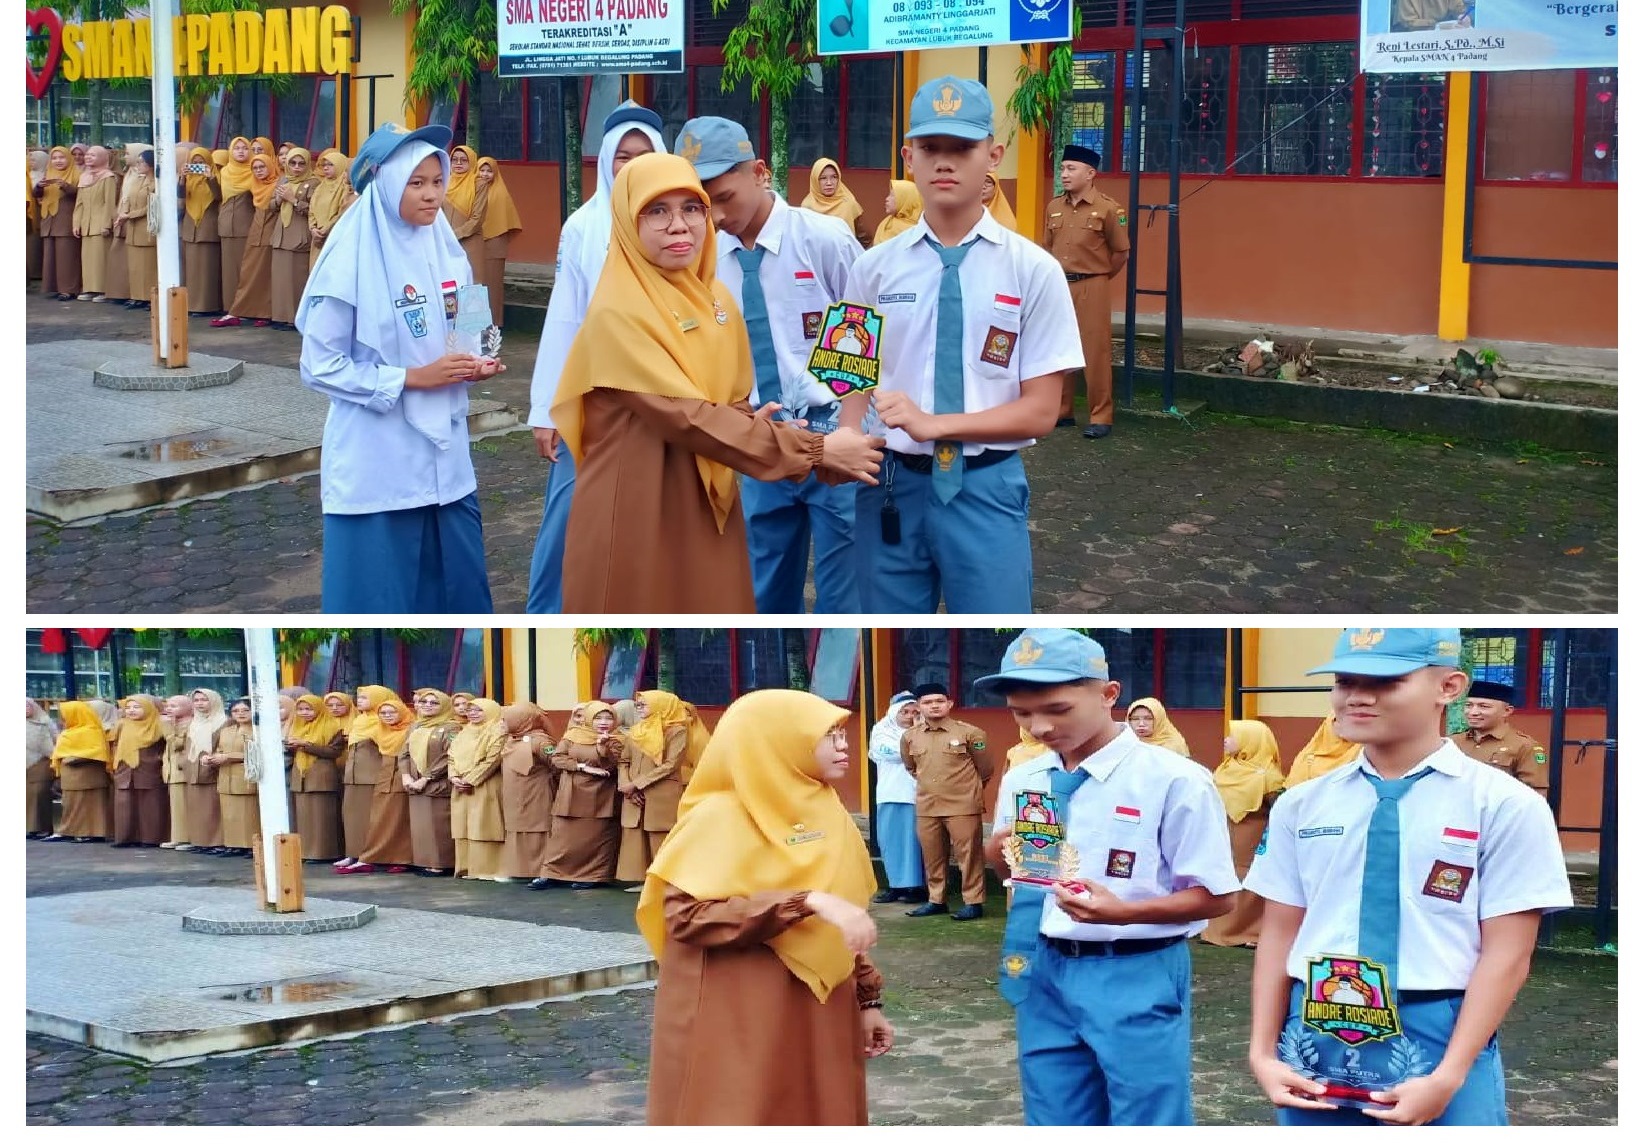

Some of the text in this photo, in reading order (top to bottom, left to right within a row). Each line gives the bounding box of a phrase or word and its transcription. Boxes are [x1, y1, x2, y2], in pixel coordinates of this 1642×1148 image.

[506, 0, 668, 25] SMA NEGERI 4 PADANG
[893, 2, 905, 13] 08
[884, 8, 996, 23] ADIBRAMANTY LINGGARJATI
[541, 27, 612, 38] TERAKREDITASI
[898, 29, 914, 37] SMA
[915, 27, 941, 35] NEGERI
[949, 24, 980, 33] PADANG
[62, 19, 152, 81] SMAN
[186, 5, 351, 77] PADANG
[885, 32, 994, 45] KECAMATAN LUBUK BEGALUNG
[1376, 41, 1401, 53] Reni
[1392, 54, 1420, 64] Kepala
[1420, 52, 1449, 63] SMAN
[1457, 52, 1488, 61] Padang
[812, 349, 878, 380] ANDRE ROSIADE
[827, 401, 842, 422] 2
[1307, 1001, 1393, 1028] ANDRE ROSIADE
[1345, 1048, 1361, 1067] 2
